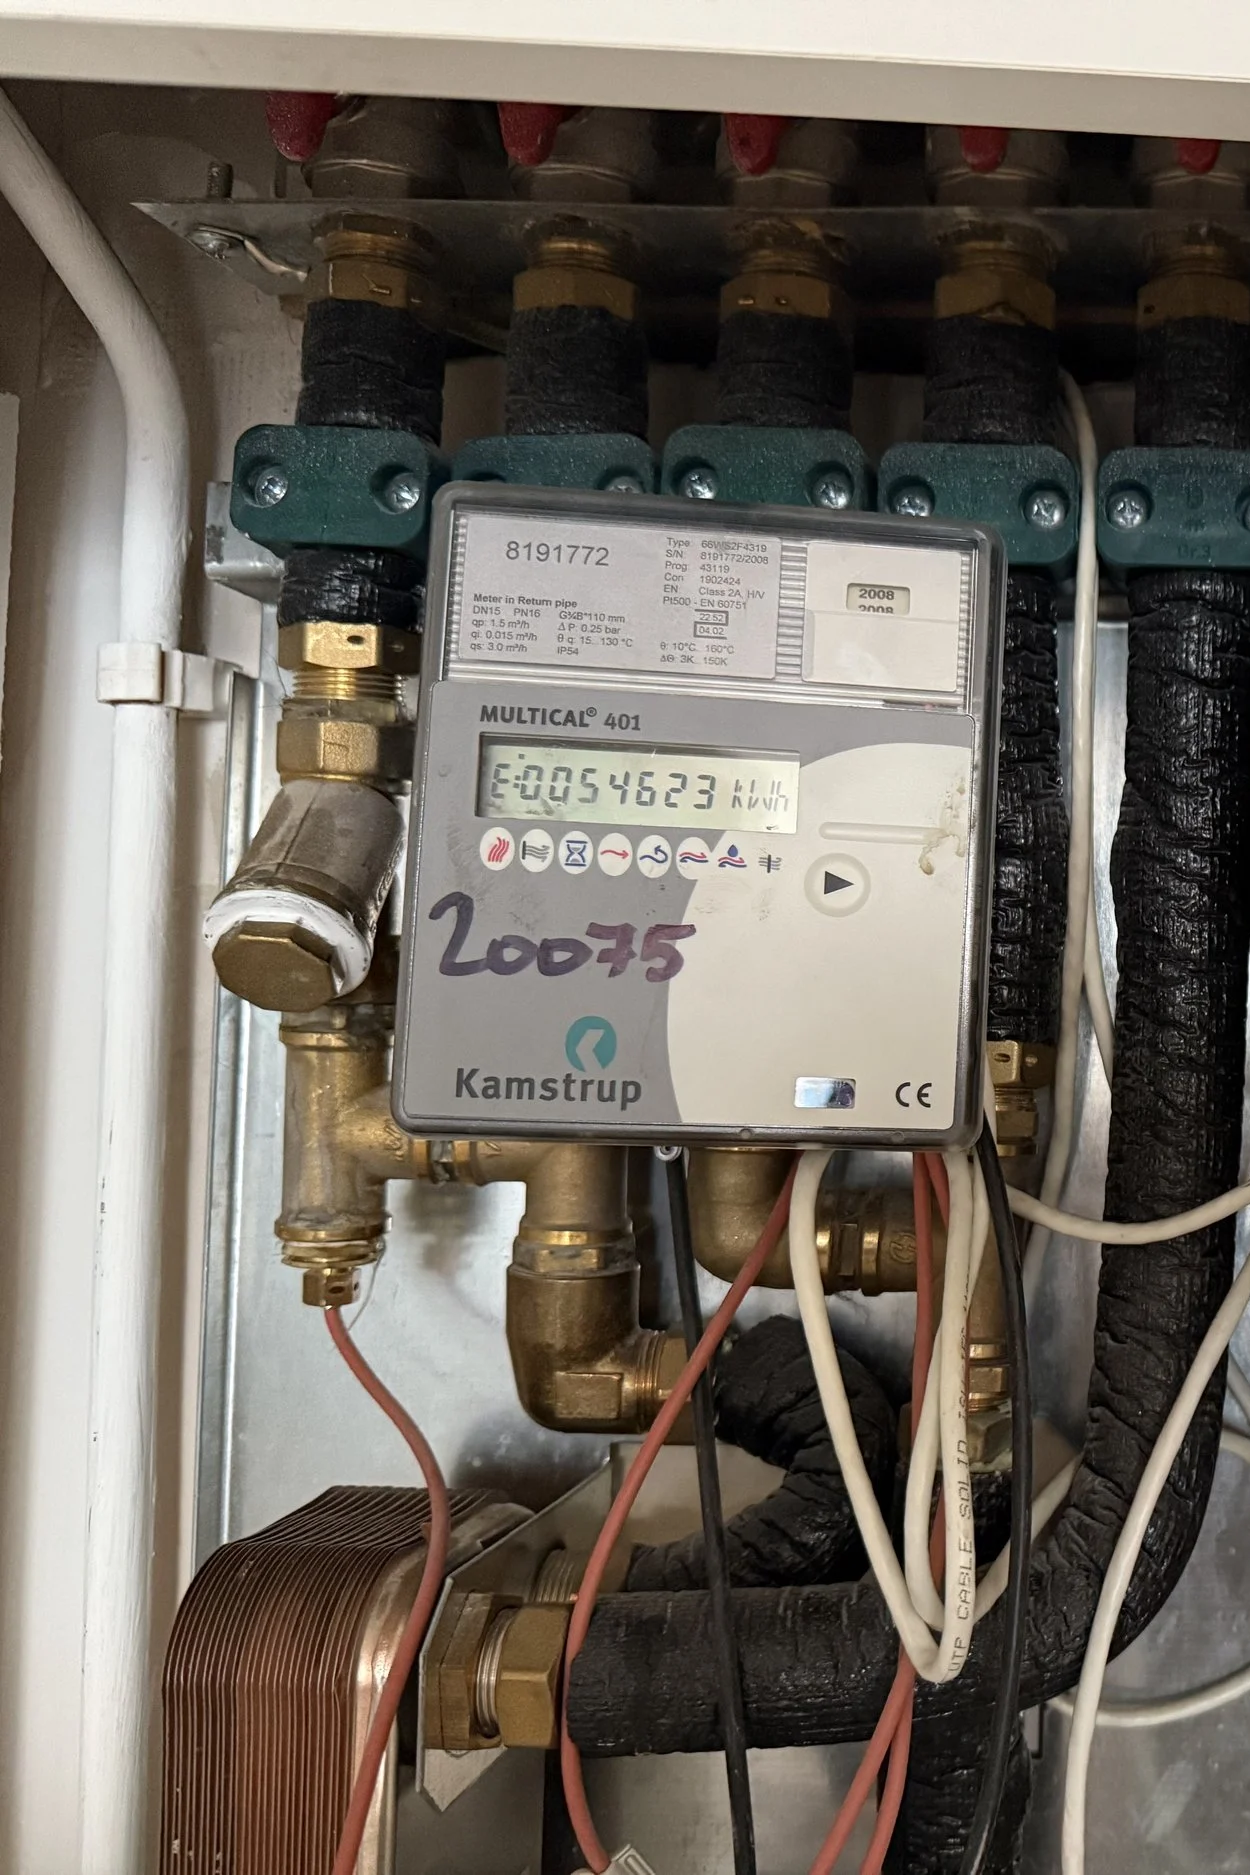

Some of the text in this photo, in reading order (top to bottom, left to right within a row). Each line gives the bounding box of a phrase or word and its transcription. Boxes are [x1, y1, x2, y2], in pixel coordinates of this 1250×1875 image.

[505, 540, 610, 567] 8191772
[700, 551, 769, 565] 8191772/2008
[700, 563, 730, 573] 43119
[700, 575, 741, 586] 1902424
[698, 586, 726, 596] Class
[858, 588, 895, 601] 2008
[473, 593, 578, 609] Meter in Return pipe
[663, 596, 691, 606] Pt500
[700, 599, 715, 608] EN
[717, 600, 747, 610] 60751
[472, 605, 541, 618] DN15 PN16
[490, 618, 506, 627] 1.5
[608, 615, 625, 623] mm
[486, 630, 513, 640] 0.015
[581, 624, 602, 633] 0.25
[604, 625, 621, 634] bar
[488, 642, 504, 651] 3.0
[557, 646, 579, 656] IP54
[603, 712, 641, 731] 401
[429, 891, 697, 983] 20075
[455, 1067, 642, 1111] Kamstrup
[956, 1543, 975, 1620] CABLE
[948, 1636, 968, 1672] UTP
